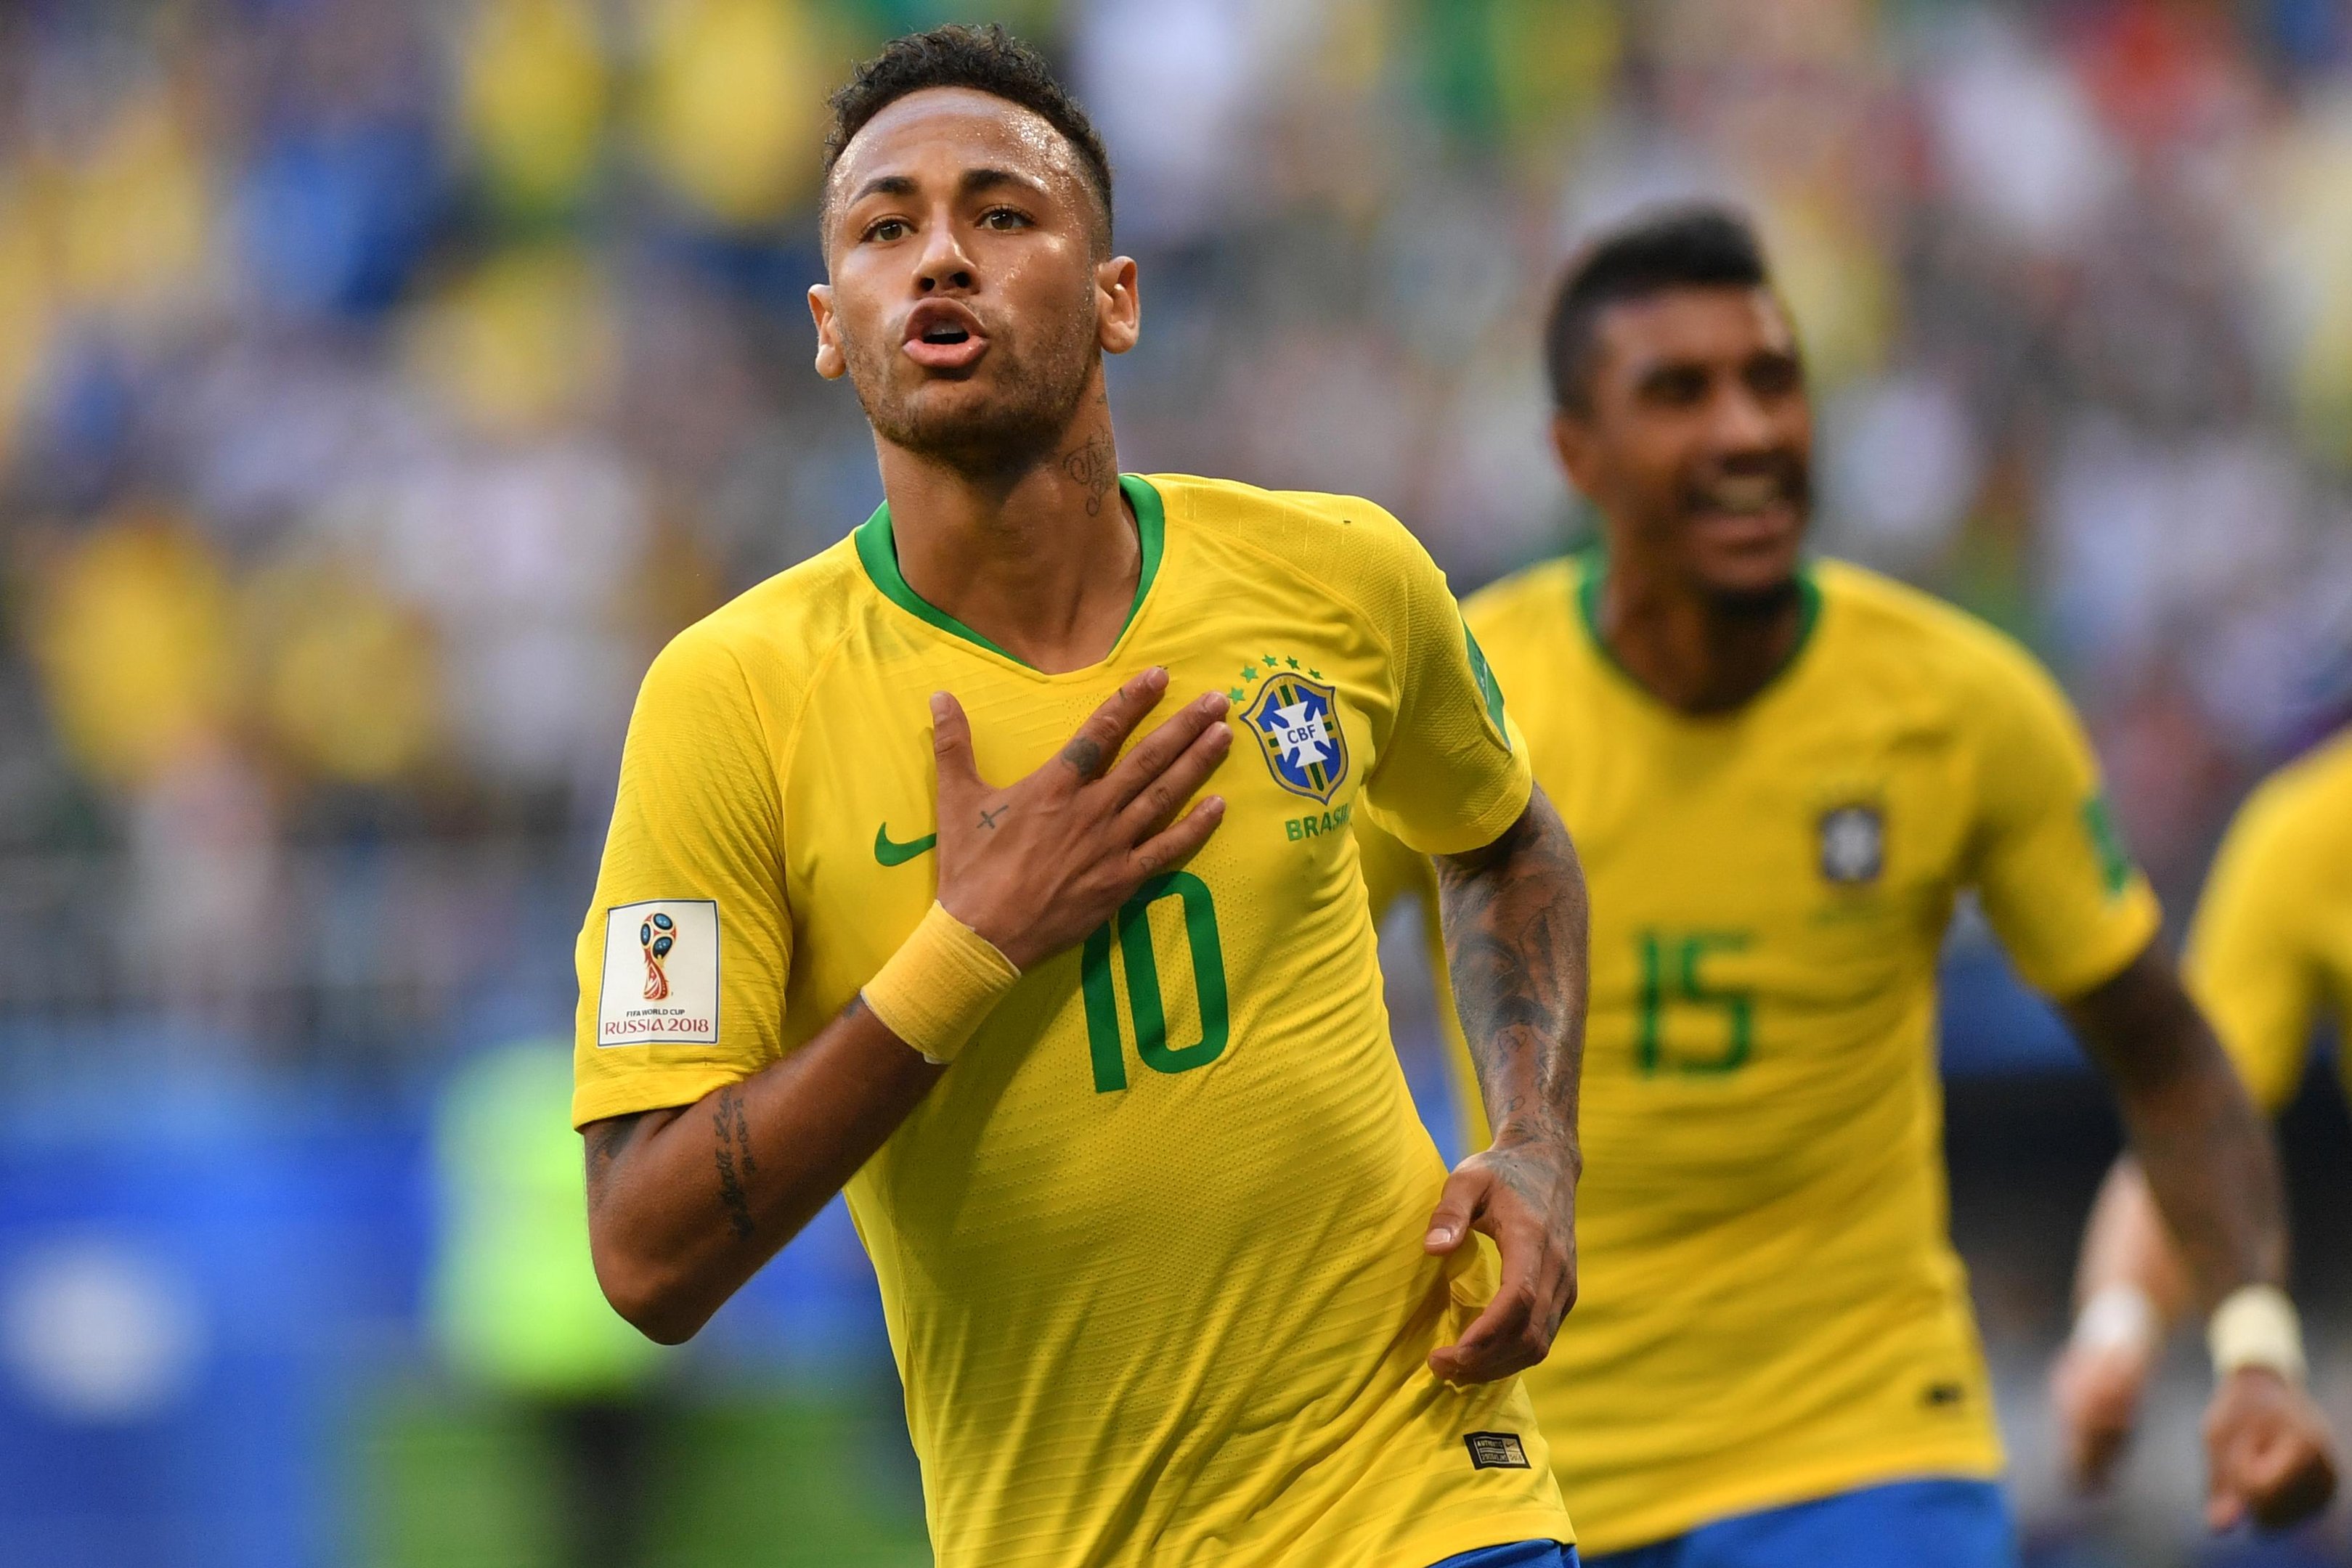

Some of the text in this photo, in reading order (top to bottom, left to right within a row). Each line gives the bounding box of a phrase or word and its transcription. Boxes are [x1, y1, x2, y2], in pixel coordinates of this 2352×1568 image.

[1287, 724, 1317, 744] CBF
[1081, 870, 1229, 1094] 10
[1635, 926, 1754, 1079] 15
[605, 1018, 709, 1035] RUSSIA 2018
